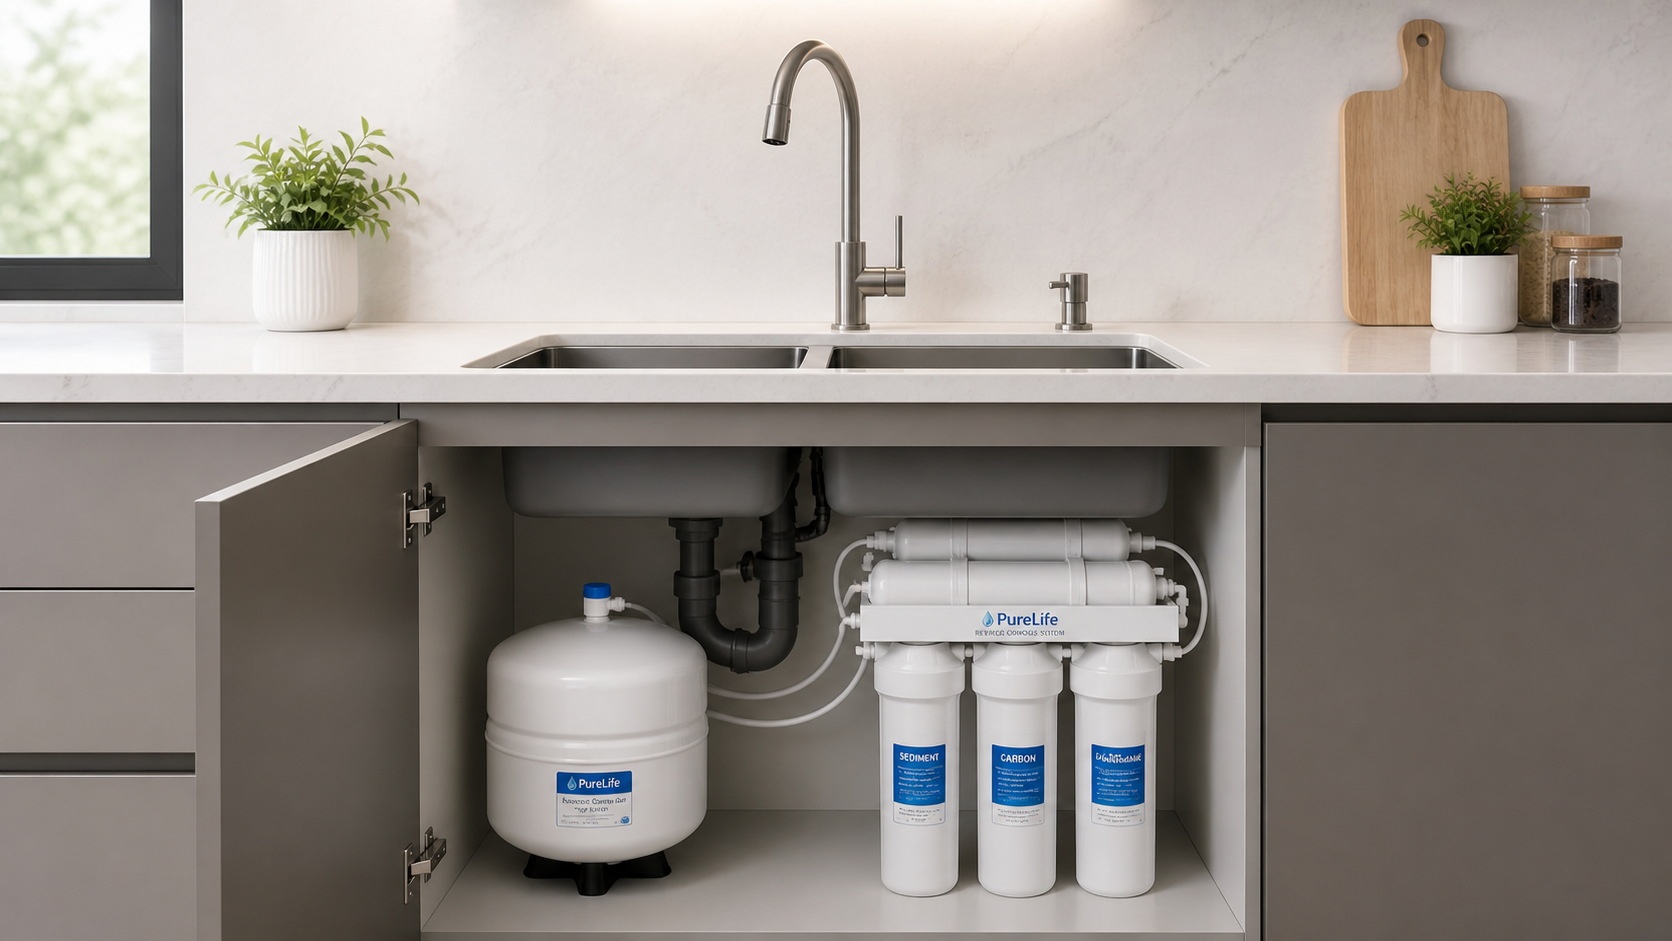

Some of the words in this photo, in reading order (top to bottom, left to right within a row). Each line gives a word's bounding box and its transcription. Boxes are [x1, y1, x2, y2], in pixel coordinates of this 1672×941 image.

[997, 612, 1059, 626] PureLife
[899, 752, 940, 762] SEDIMENT
[1000, 753, 1036, 763] CARBON
[578, 777, 621, 789] PureLife
